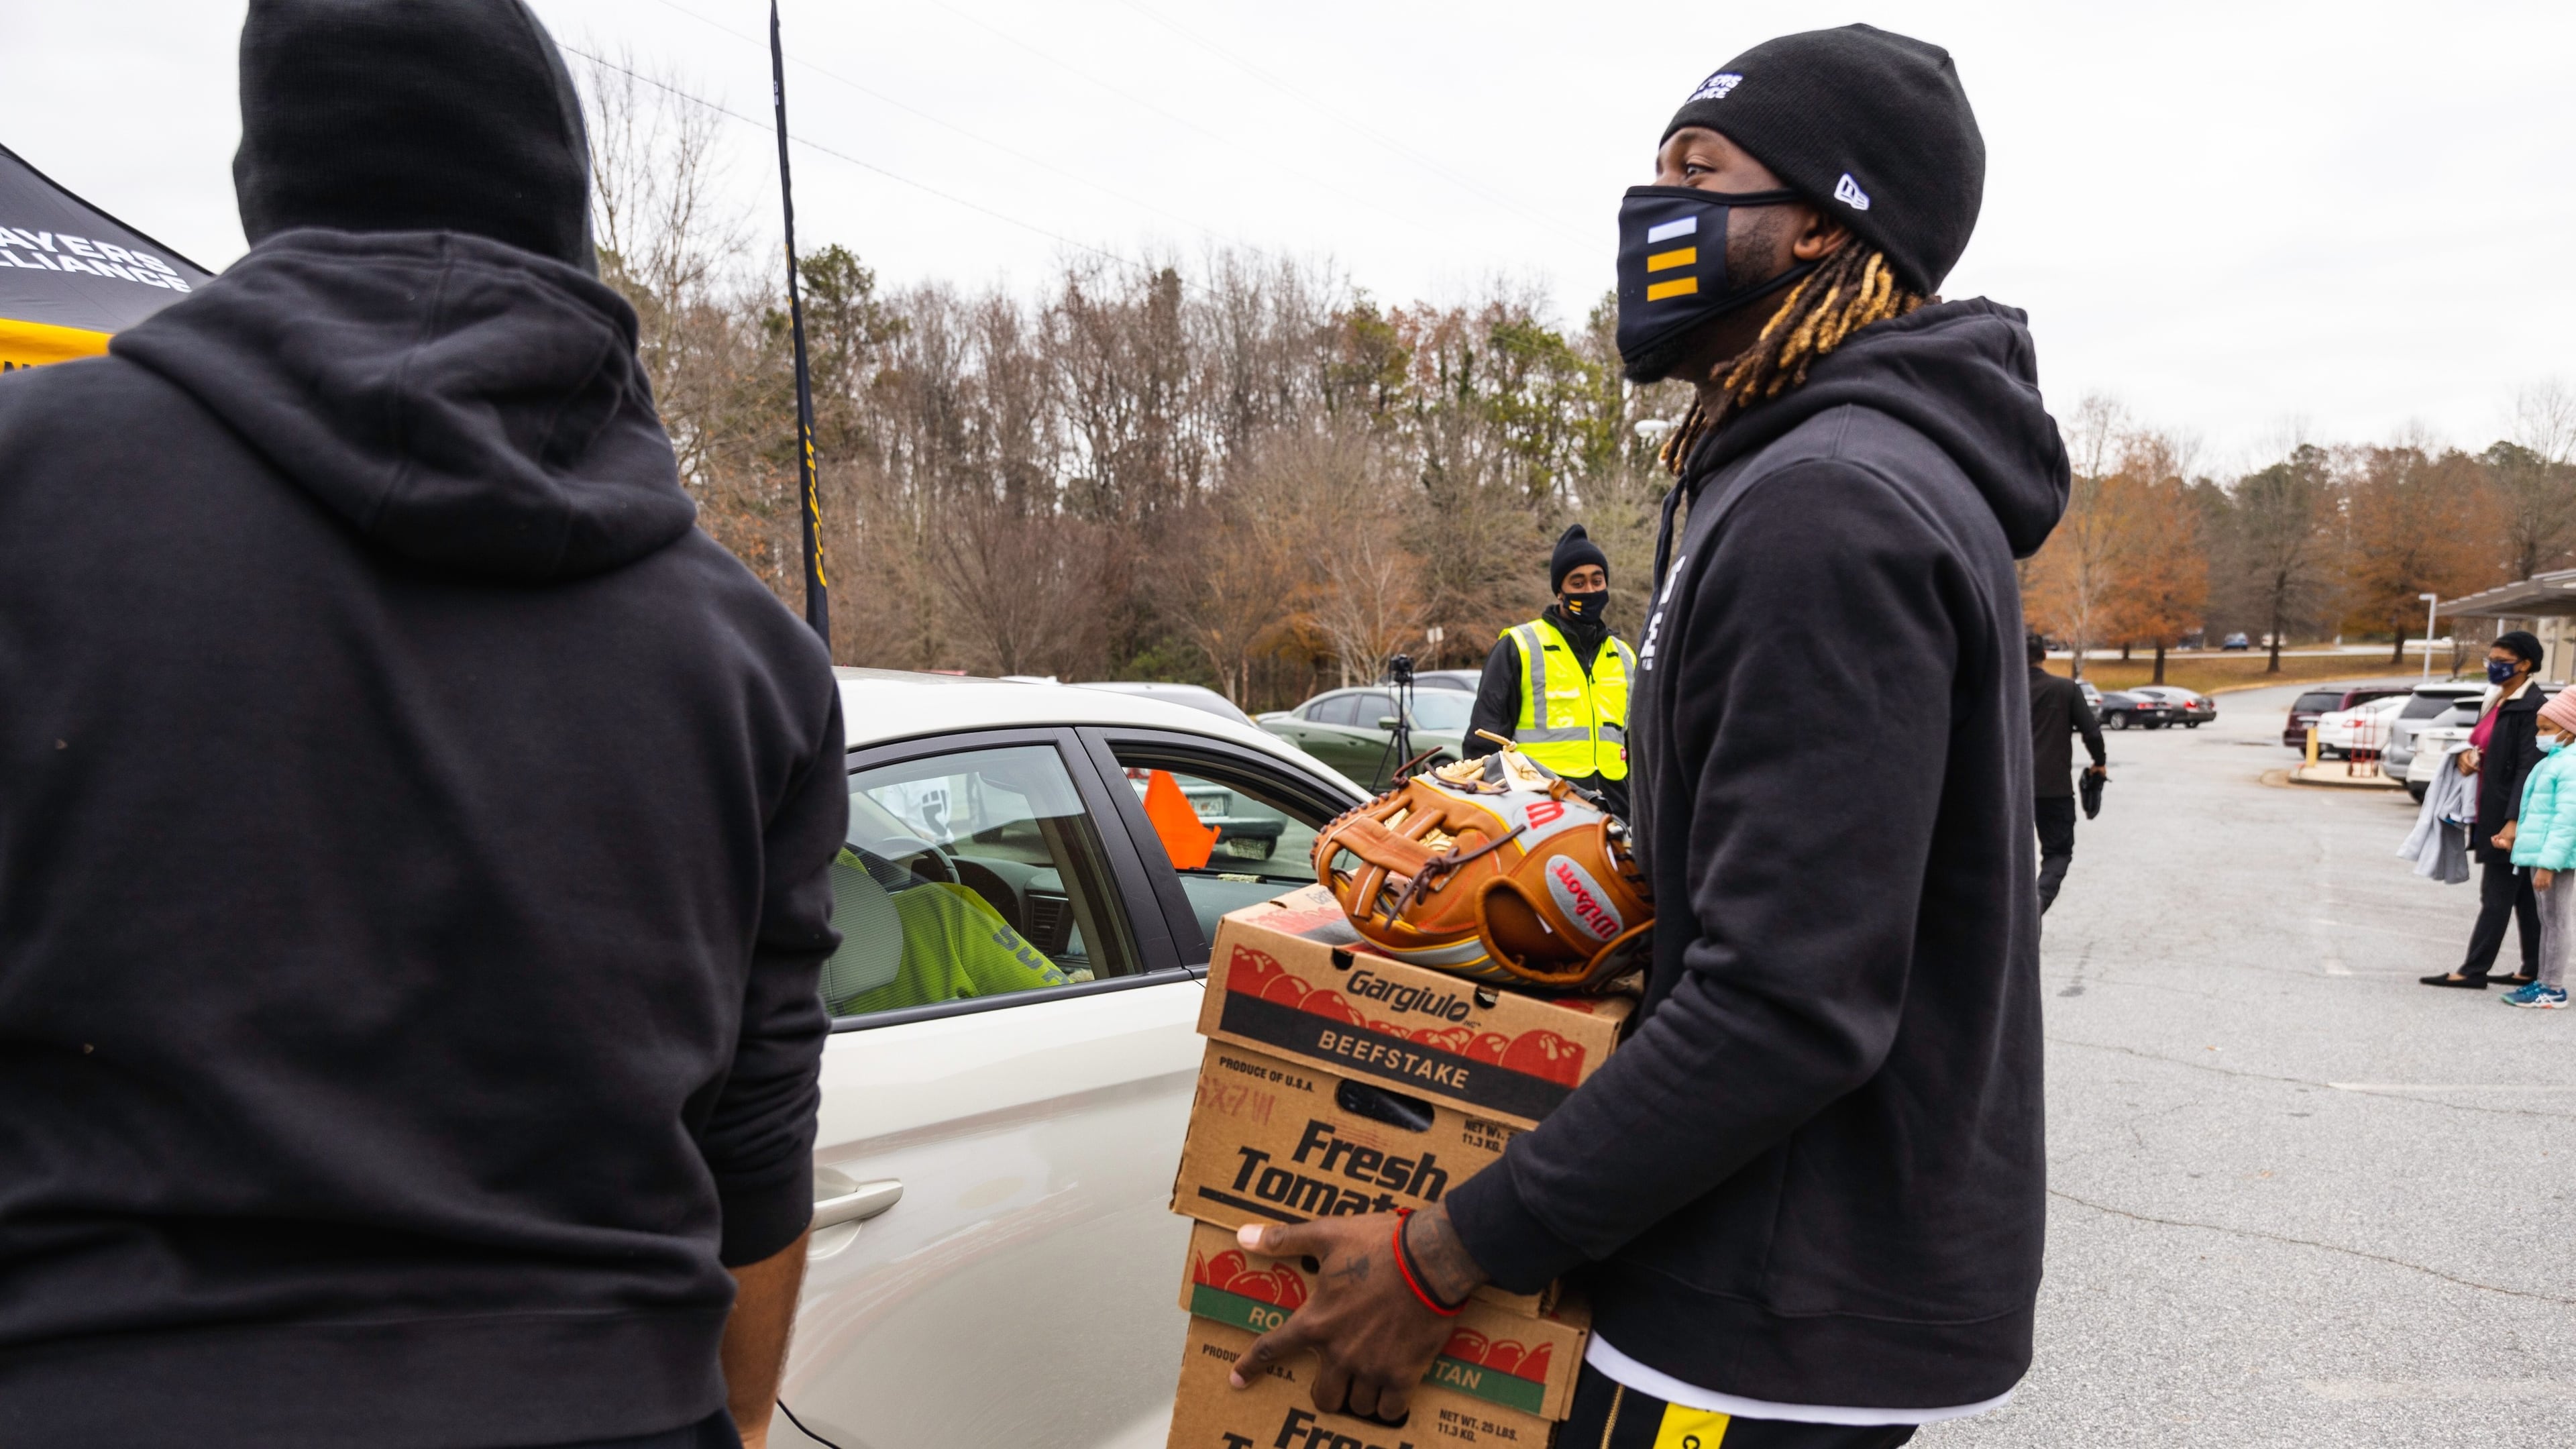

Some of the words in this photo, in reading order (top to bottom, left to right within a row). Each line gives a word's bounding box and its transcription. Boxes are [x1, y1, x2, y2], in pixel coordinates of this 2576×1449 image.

[1550, 862, 1620, 939] Wilson
[1346, 970, 1470, 1022] Gargiulo
[1220, 1056, 1267, 1079] PRODUCE
[1269, 1070, 1283, 1083] OF
[1318, 1030, 1470, 1089] BEEFSTAKE
[1464, 1119, 1485, 1134] NET
[1291, 1118, 1448, 1203] Fresh
[1232, 1146, 1399, 1216] Tomat
[1248, 1306, 1283, 1330] RO
[1202, 1343, 1242, 1363] PRODU
[1438, 1423, 1458, 1437] 11.3
[1439, 1409, 1460, 1424] NET
[1461, 1415, 1479, 1430] WT.
[1481, 1421, 1494, 1434] 25
[1496, 1425, 1517, 1442] LBS.
